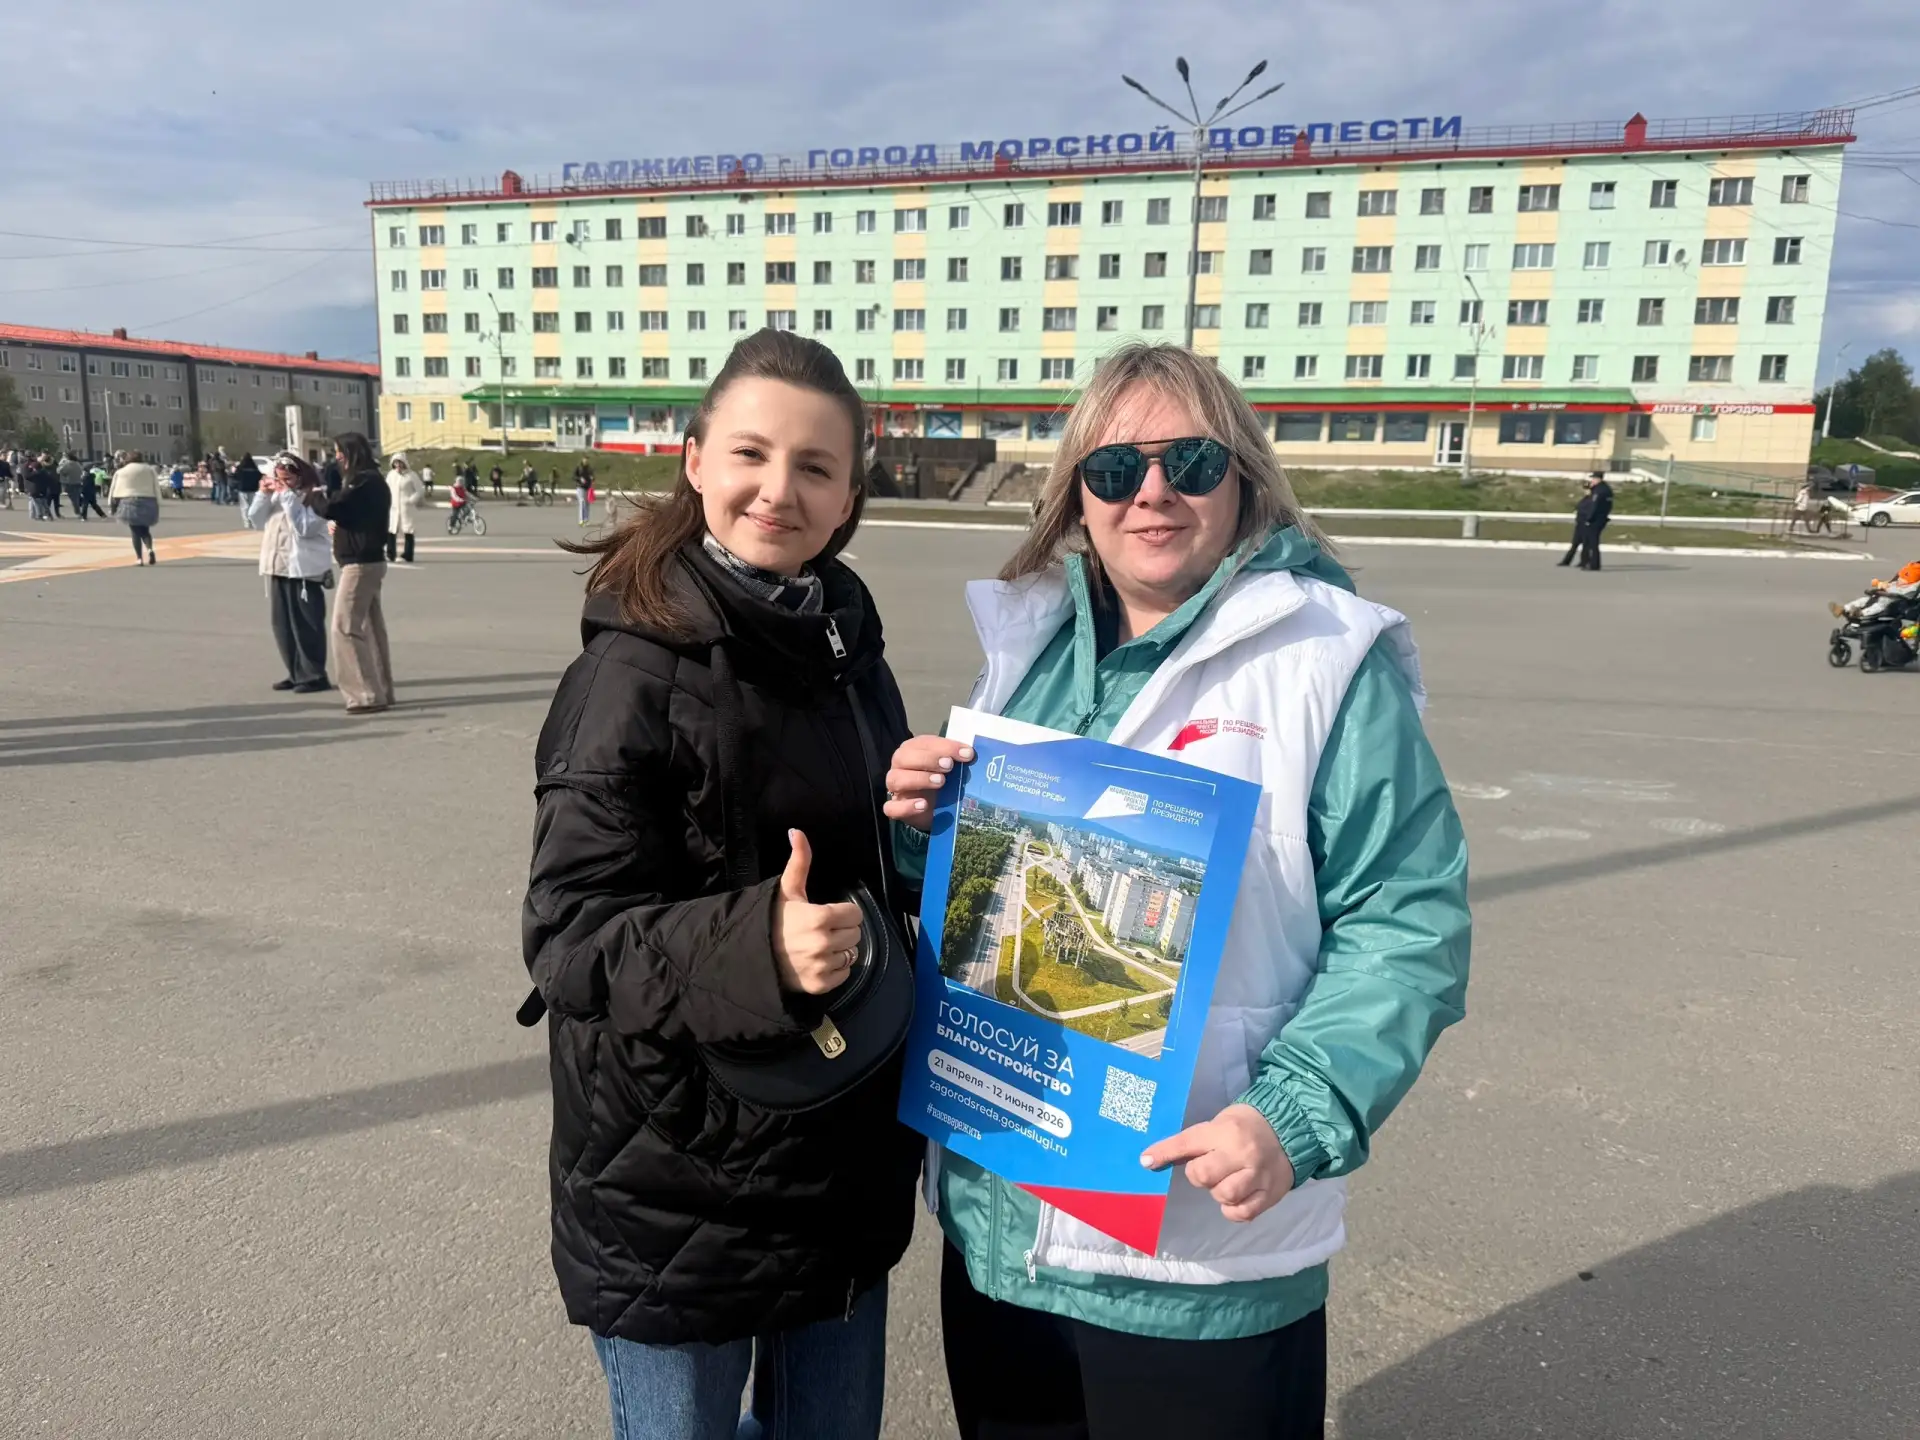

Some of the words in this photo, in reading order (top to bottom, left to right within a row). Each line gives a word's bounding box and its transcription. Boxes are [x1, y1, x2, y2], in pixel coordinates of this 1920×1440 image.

[562, 153, 764, 181] ГАДЖИЕВО
[808, 144, 938, 169] ГОРОД
[960, 125, 1176, 161] МОРСКОЙ
[1207, 115, 1463, 151] ДОБЛЕСТИ
[1652, 404, 1698, 414] АПТЕКИ
[1002, 780, 1041, 796] ГОРОДСКОЙ
[1150, 806, 1200, 827] ПРЕЗИДЕНТА
[1152, 799, 1164, 808] ПО
[1165, 803, 1204, 820] РЕШЕНИЮ
[936, 1023, 1072, 1096] БЛАГОУСТРОЙСТВО
[938, 1000, 1040, 1061] ГОЛОСУЙ
[1043, 1048, 1075, 1079] ЗА
[929, 1079, 1068, 1157] zagorodsreda.gosuslugi.ru
[933, 1056, 944, 1069] 21
[945, 1063, 984, 1089] апреля
[992, 1084, 1003, 1098] 12
[1004, 1094, 1035, 1115] июня
[1036, 1107, 1064, 1129] 2026
